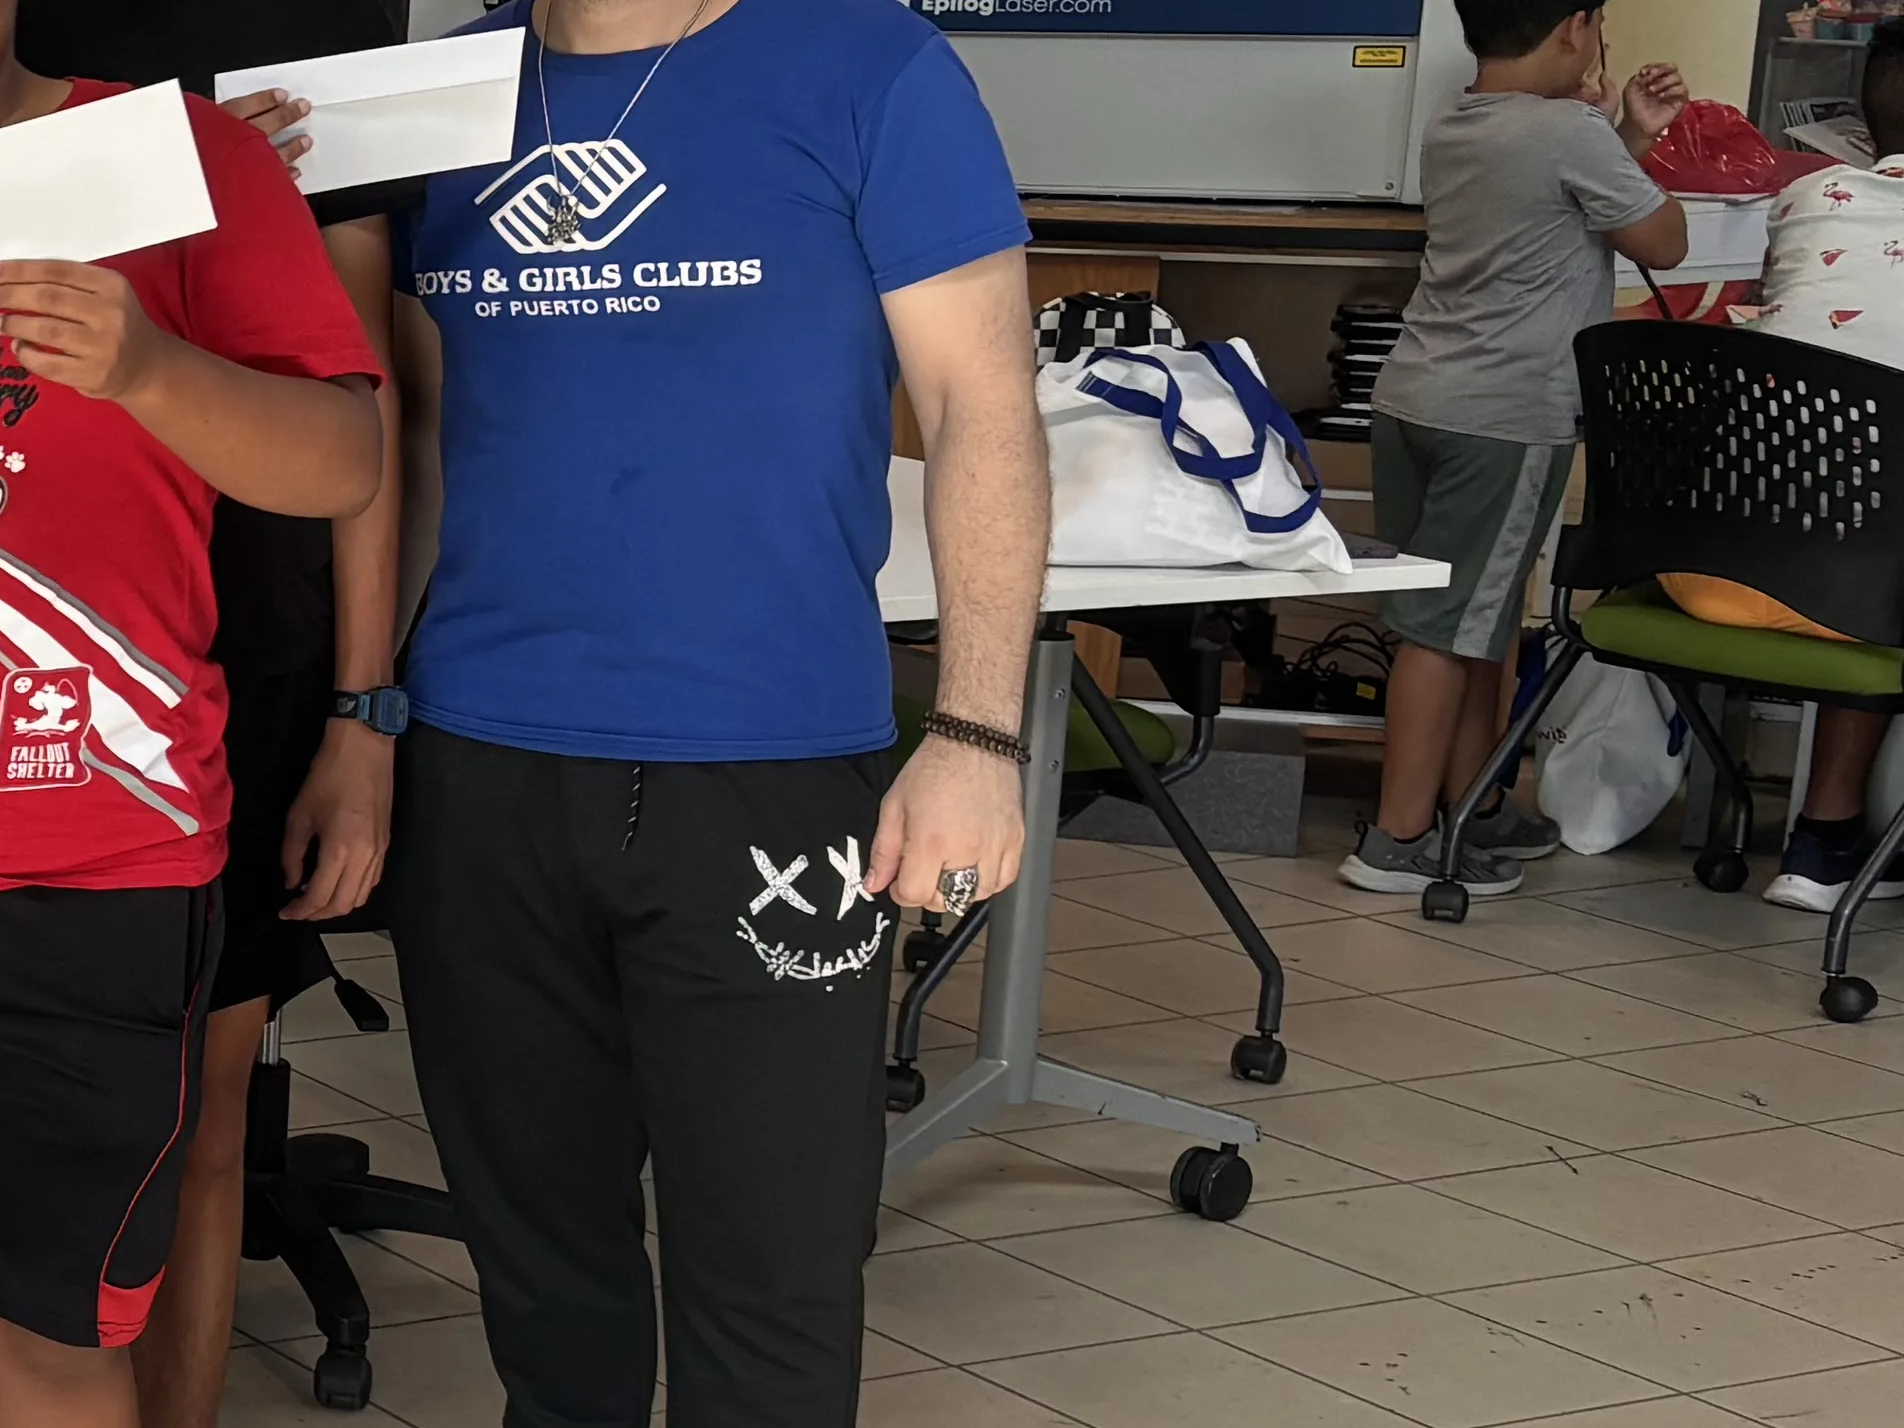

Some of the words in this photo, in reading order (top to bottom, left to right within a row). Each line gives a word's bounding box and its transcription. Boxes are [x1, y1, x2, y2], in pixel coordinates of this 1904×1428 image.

[415, 269, 472, 296] BOYS
[481, 267, 510, 294] &
[518, 263, 623, 292] GIRLS
[632, 259, 763, 288] CLUBS
[474, 301, 502, 318] OF
[510, 298, 599, 316] PUERTO
[606, 295, 661, 314] RICO
[10, 742, 70, 762] FALLOUT
[6, 762, 75, 780] SHELTER
